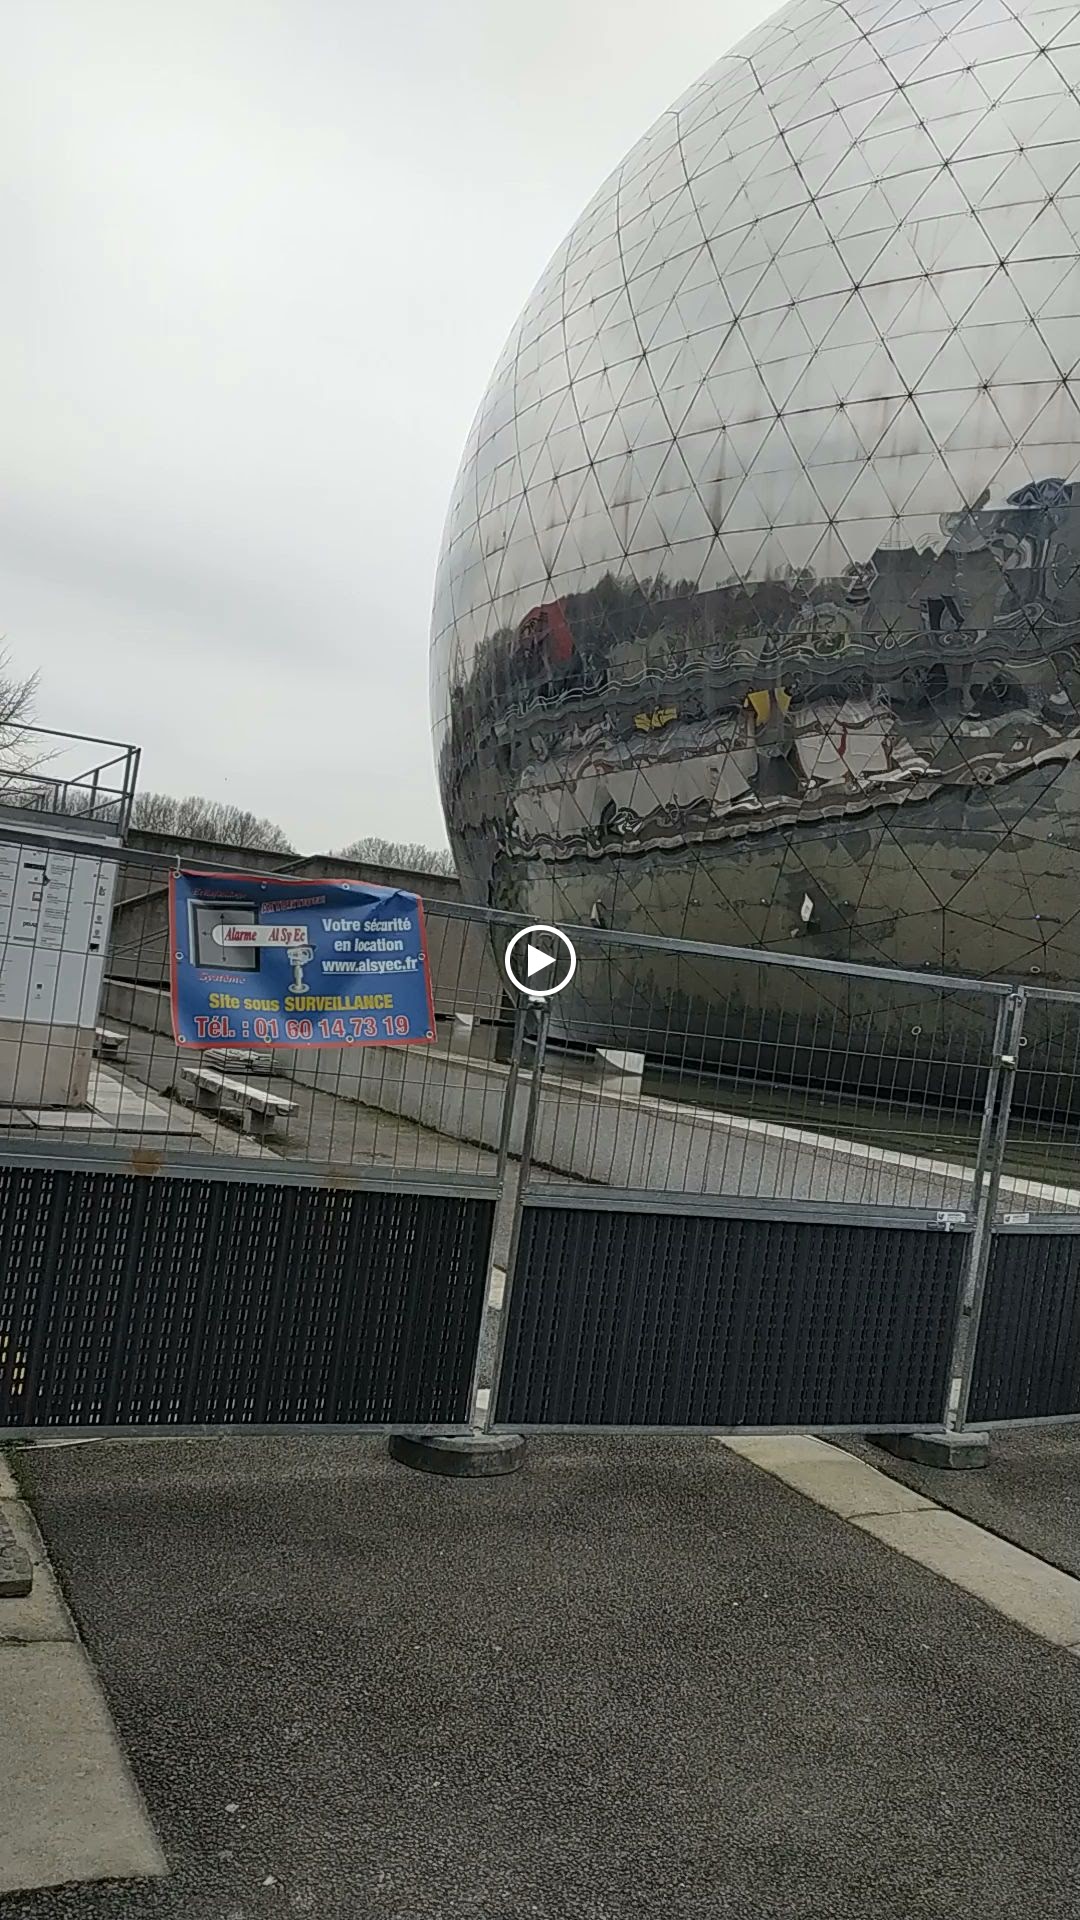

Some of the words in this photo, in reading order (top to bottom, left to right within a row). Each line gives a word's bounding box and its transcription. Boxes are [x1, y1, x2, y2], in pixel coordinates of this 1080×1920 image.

[322, 918, 361, 932] Votre
[363, 916, 411, 932] sécurité
[224, 928, 257, 942] Alarme
[334, 939, 351, 952] en
[354, 938, 403, 952] location
[322, 957, 418, 974] www.alsyec.fr
[209, 993, 240, 1009] Site
[243, 998, 280, 1011] sous
[284, 994, 394, 1011] SURVEILLANCE
[194, 1017, 235, 1038] Tél.
[253, 1018, 279, 1039] 01
[285, 1019, 312, 1039] 60
[318, 1018, 344, 1038] 14
[350, 1017, 377, 1037] 73
[382, 1015, 410, 1035] 19
